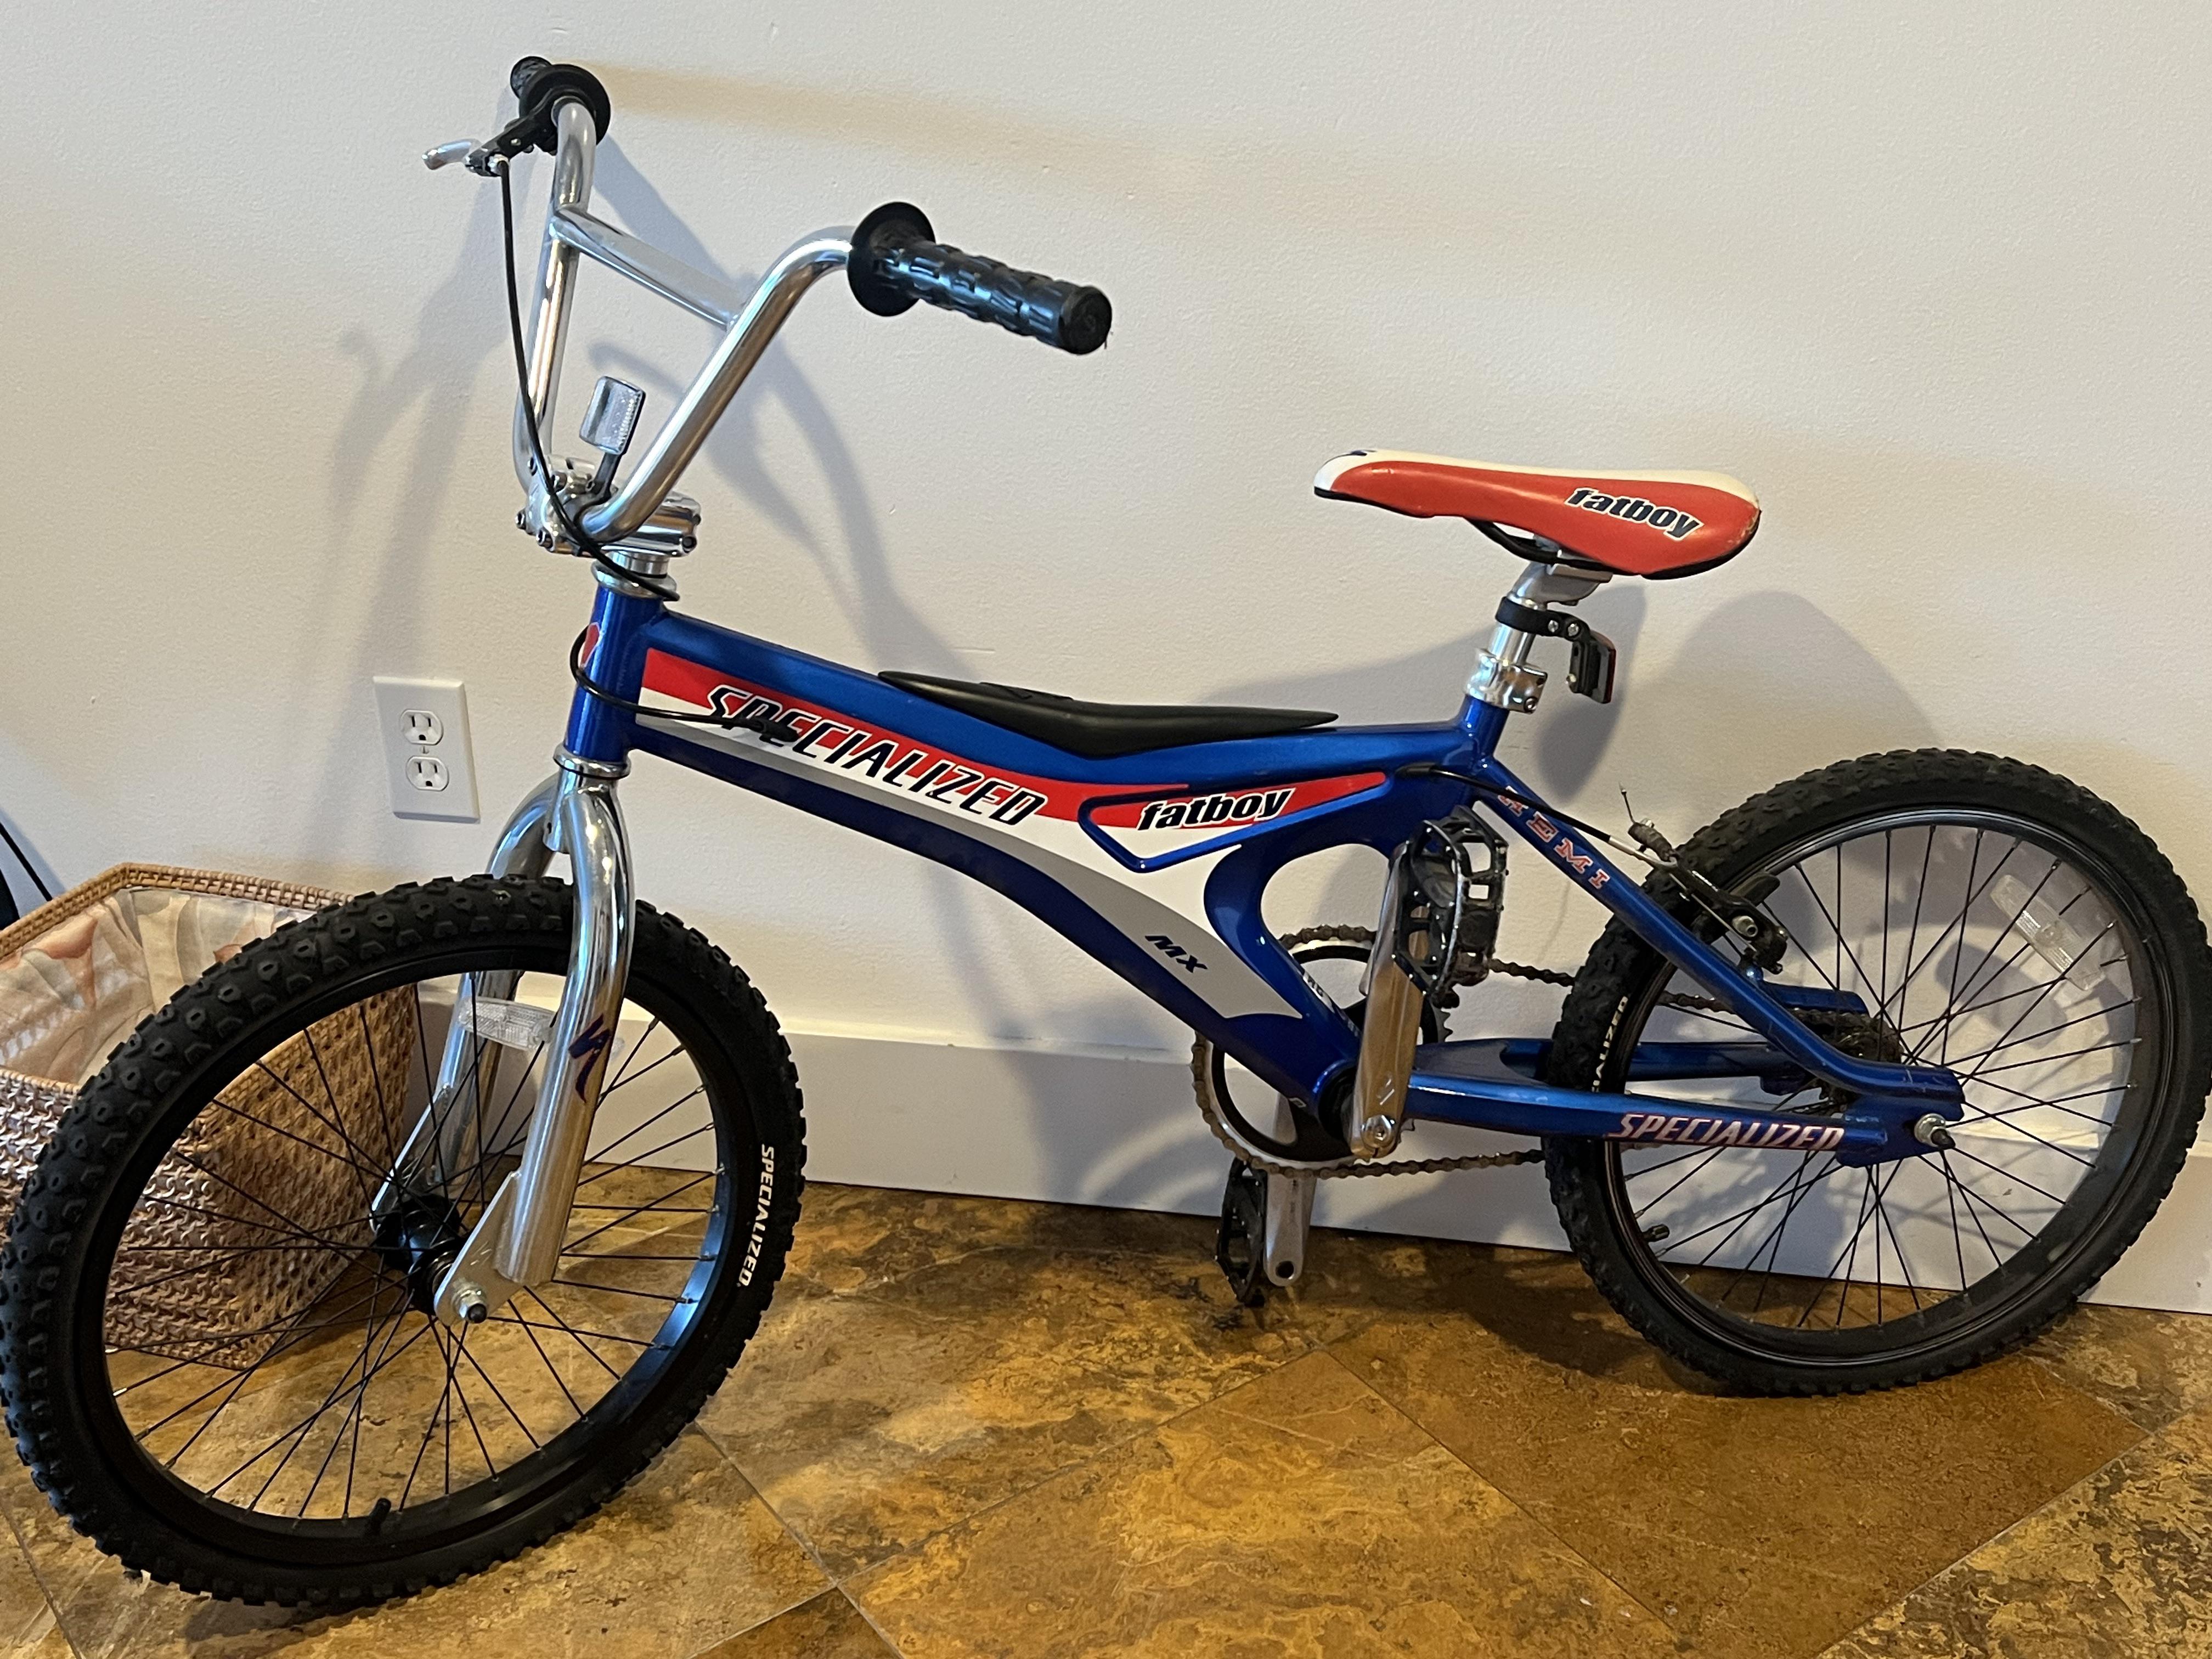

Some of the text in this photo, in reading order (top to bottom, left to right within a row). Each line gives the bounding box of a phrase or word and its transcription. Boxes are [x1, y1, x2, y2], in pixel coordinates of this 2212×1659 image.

[1564, 487, 1704, 541] fatboy
[707, 685, 1047, 826] SPECIALIZED
[1136, 788, 1296, 831] fatboy
[1145, 934, 1207, 973] MX
[1609, 1114, 1845, 1150] SPECIALIZED
[739, 1144, 775, 1286] SPECIALIZED
